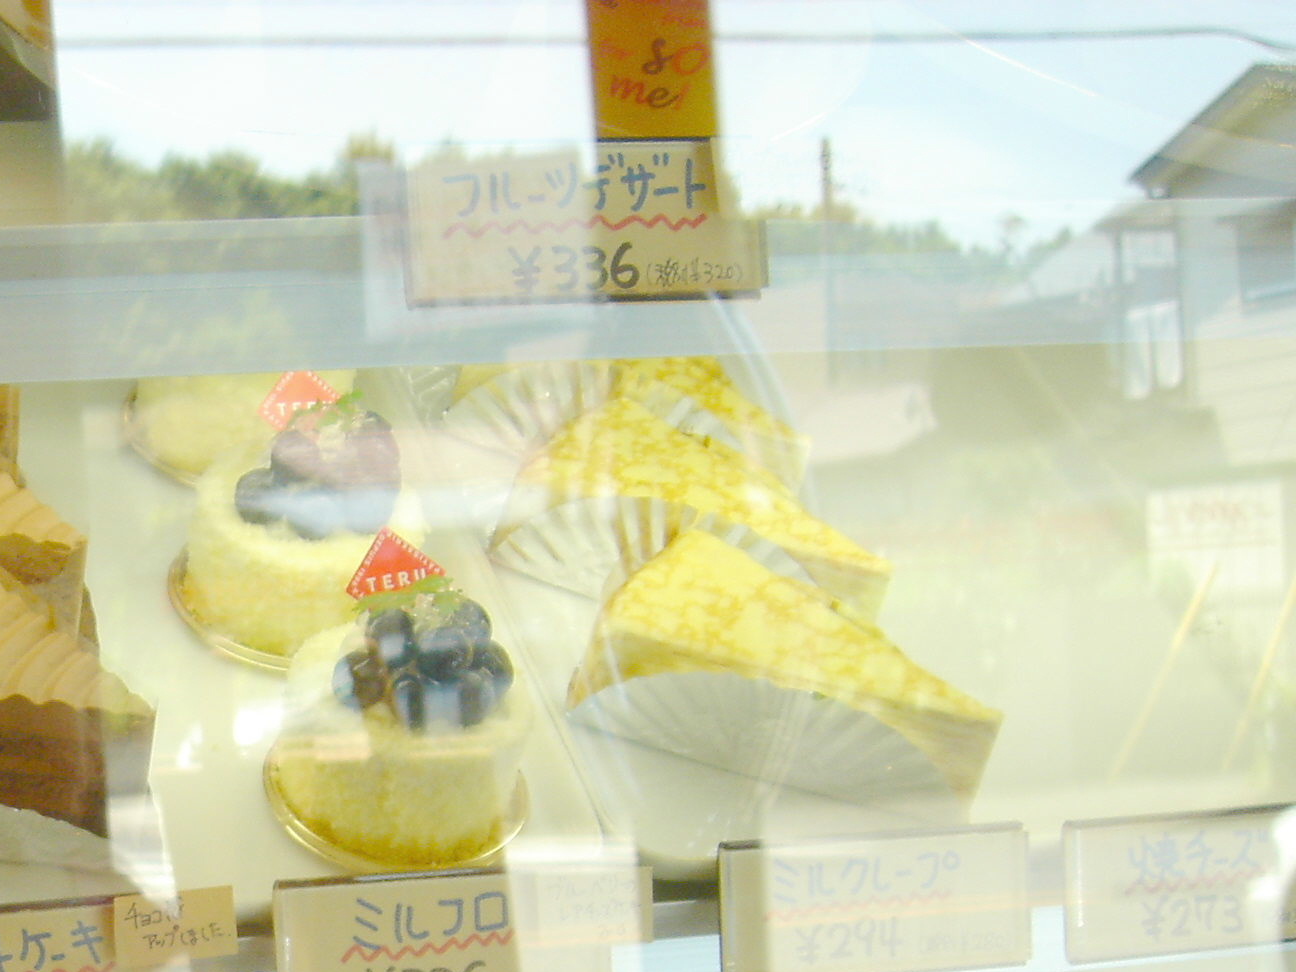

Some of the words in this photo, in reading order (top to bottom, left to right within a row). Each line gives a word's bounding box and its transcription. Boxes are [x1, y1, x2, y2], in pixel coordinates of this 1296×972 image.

[442, 152, 707, 216] フルーツデザート
[507, 241, 642, 295] ¥336
[366, 567, 427, 592] TERU
